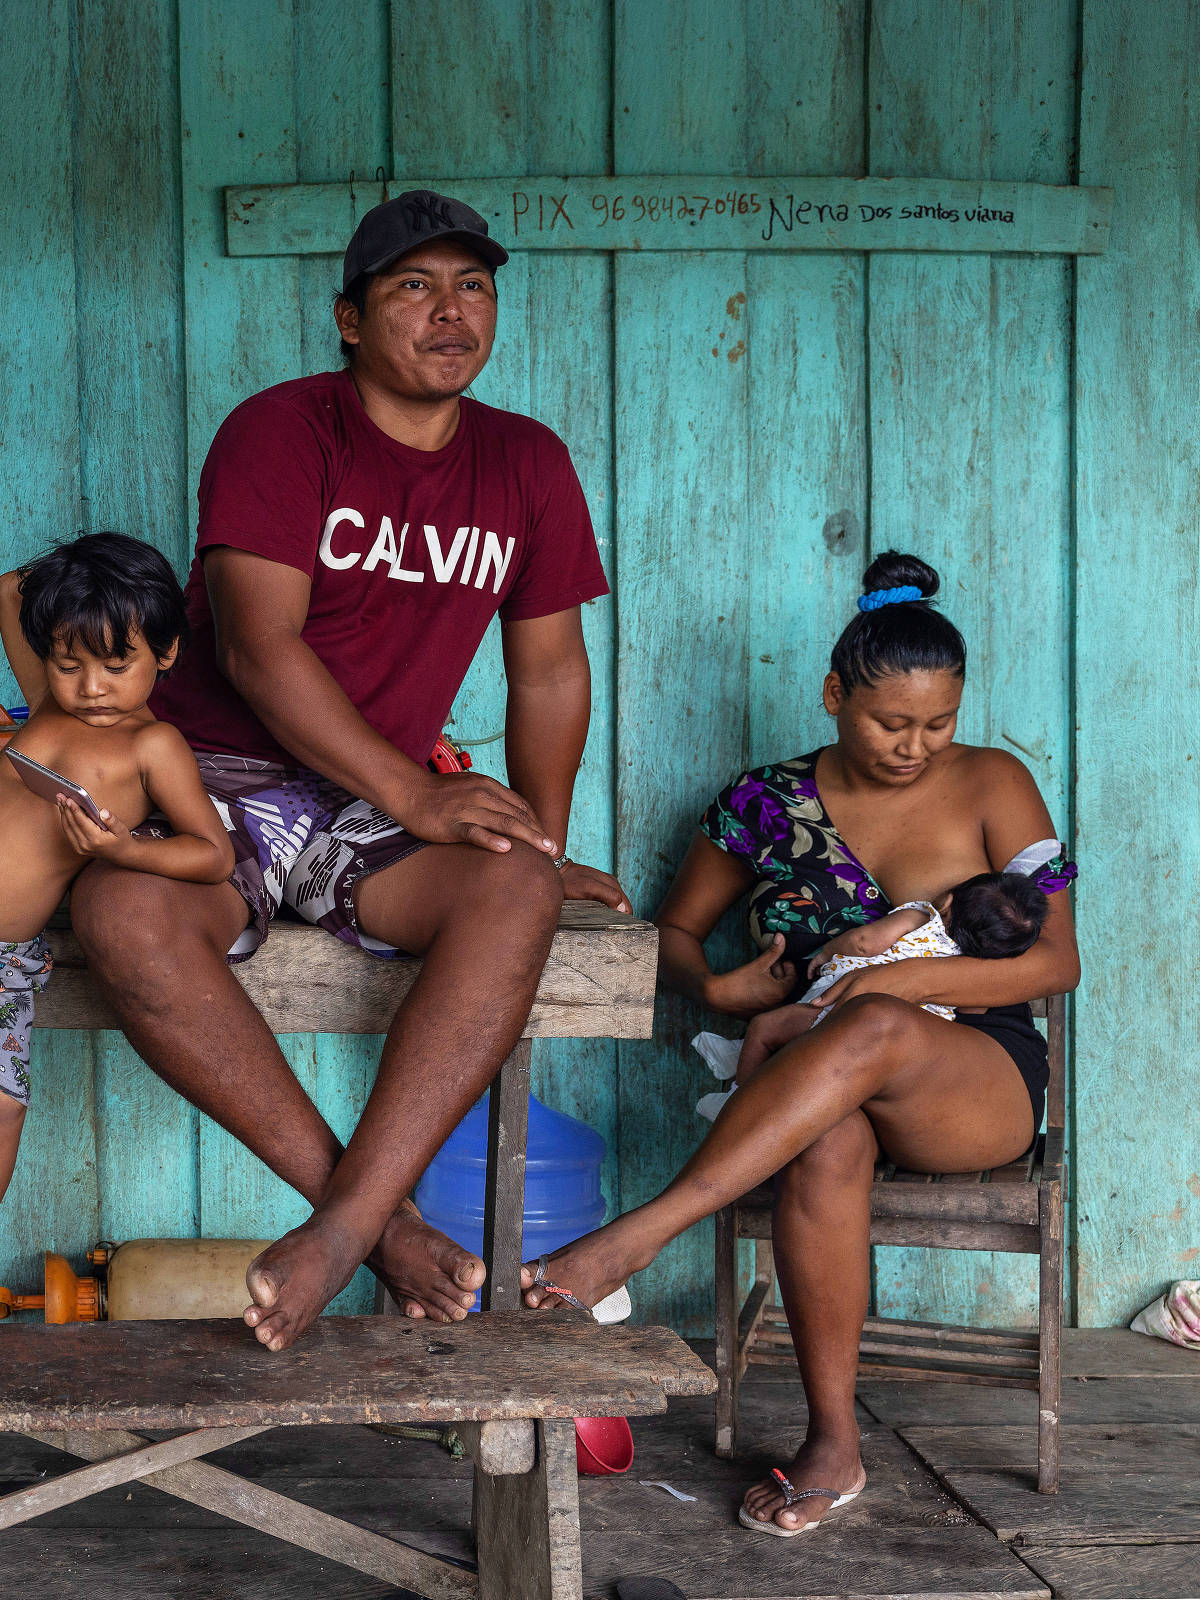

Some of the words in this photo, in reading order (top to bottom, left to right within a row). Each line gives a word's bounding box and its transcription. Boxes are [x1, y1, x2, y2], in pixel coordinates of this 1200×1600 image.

[513, 192, 574, 236] PIX
[762, 194, 849, 241] Nena
[858, 204, 893, 223] Dos
[899, 202, 960, 223] santos
[318, 507, 516, 594] CALVIN
